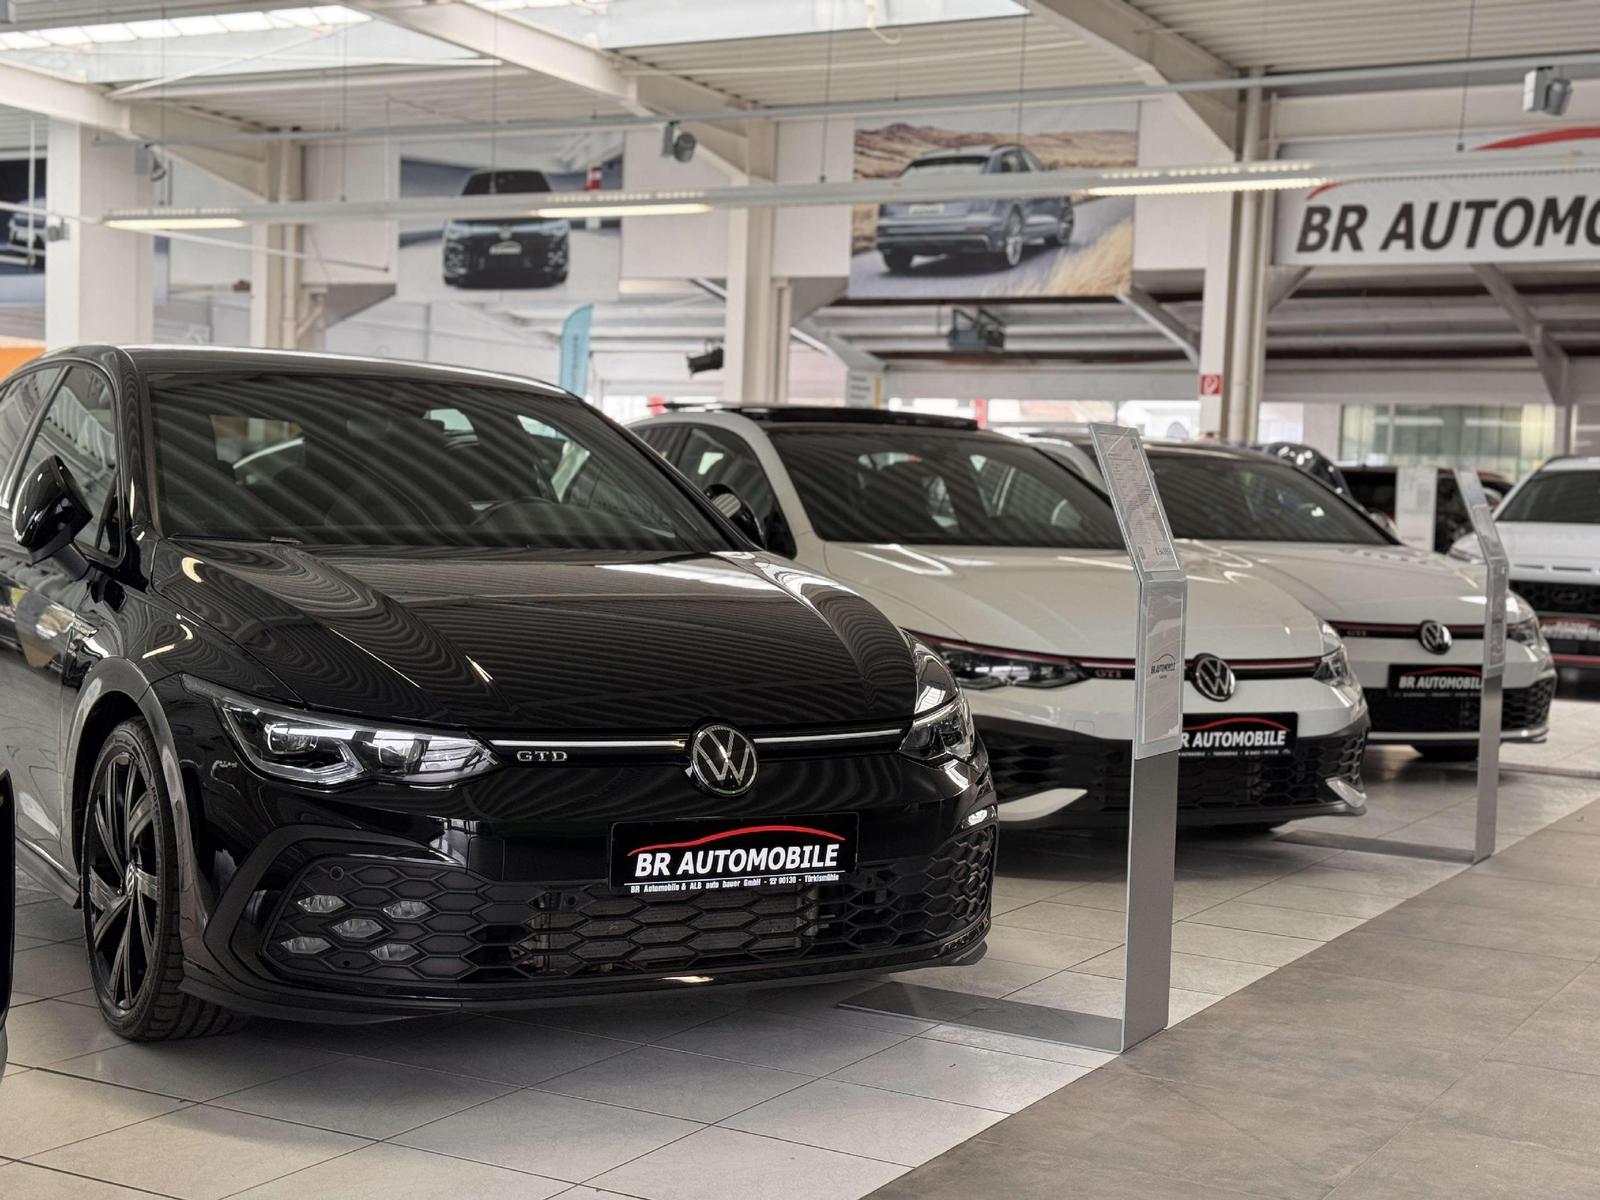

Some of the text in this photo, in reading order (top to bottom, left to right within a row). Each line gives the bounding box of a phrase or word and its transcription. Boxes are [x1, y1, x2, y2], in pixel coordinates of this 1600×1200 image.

[1296, 204, 1368, 254] BR
[1398, 676, 1483, 689] BR AUTOMOBIL
[1181, 730, 1287, 748] R AUTOMOBILE
[516, 750, 568, 762] GTD
[634, 843, 840, 877] BR AUTOMOBILE
[630, 885, 640, 894] BR
[743, 878, 761, 887] GmbH
